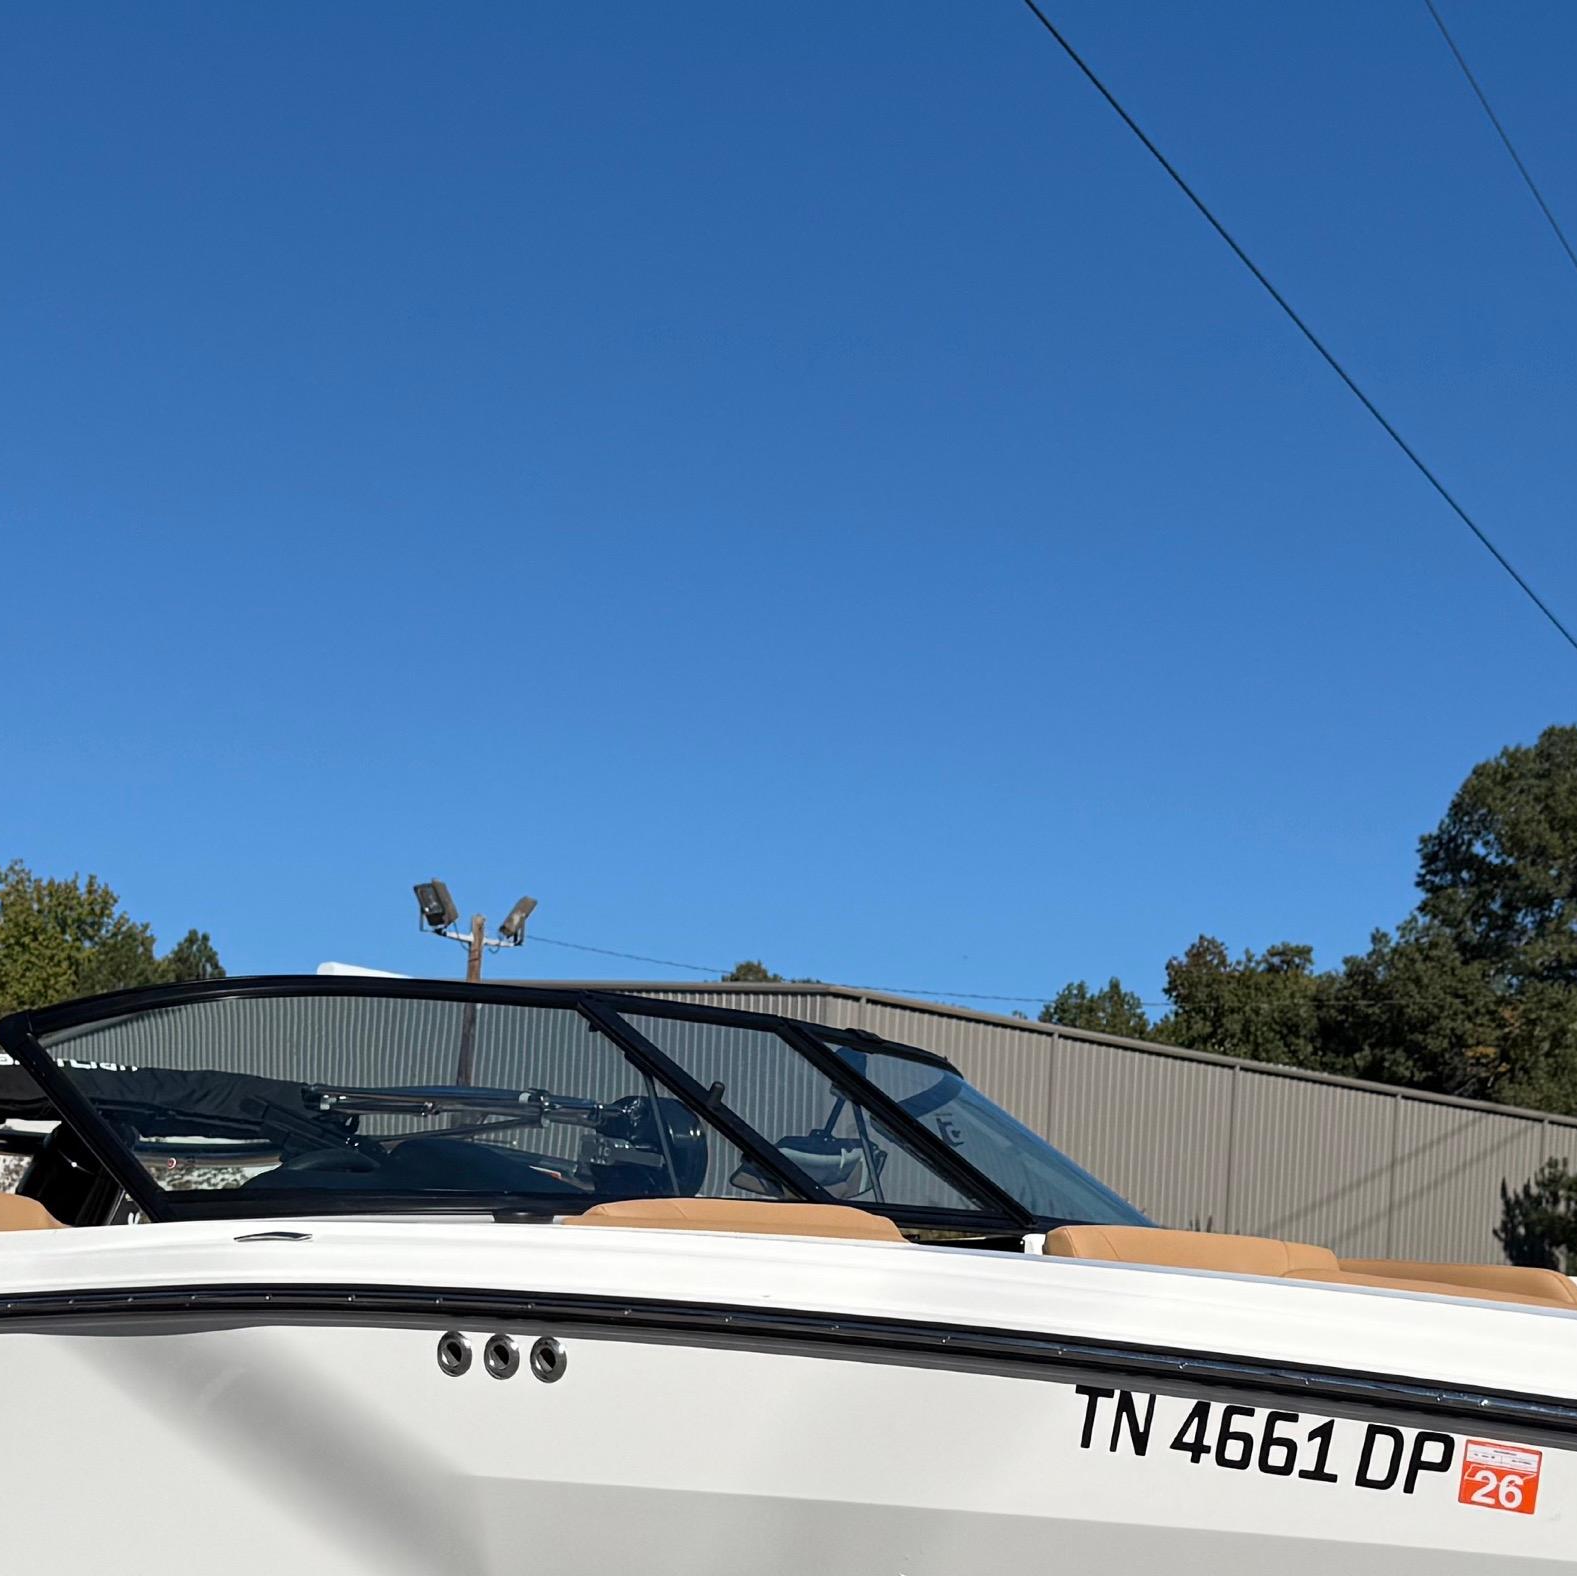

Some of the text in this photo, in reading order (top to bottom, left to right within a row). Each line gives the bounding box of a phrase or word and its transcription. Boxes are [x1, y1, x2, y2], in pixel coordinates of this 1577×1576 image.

[1075, 1384, 1455, 1494] TN 4661 DP
[1471, 1470, 1524, 1509] 26
